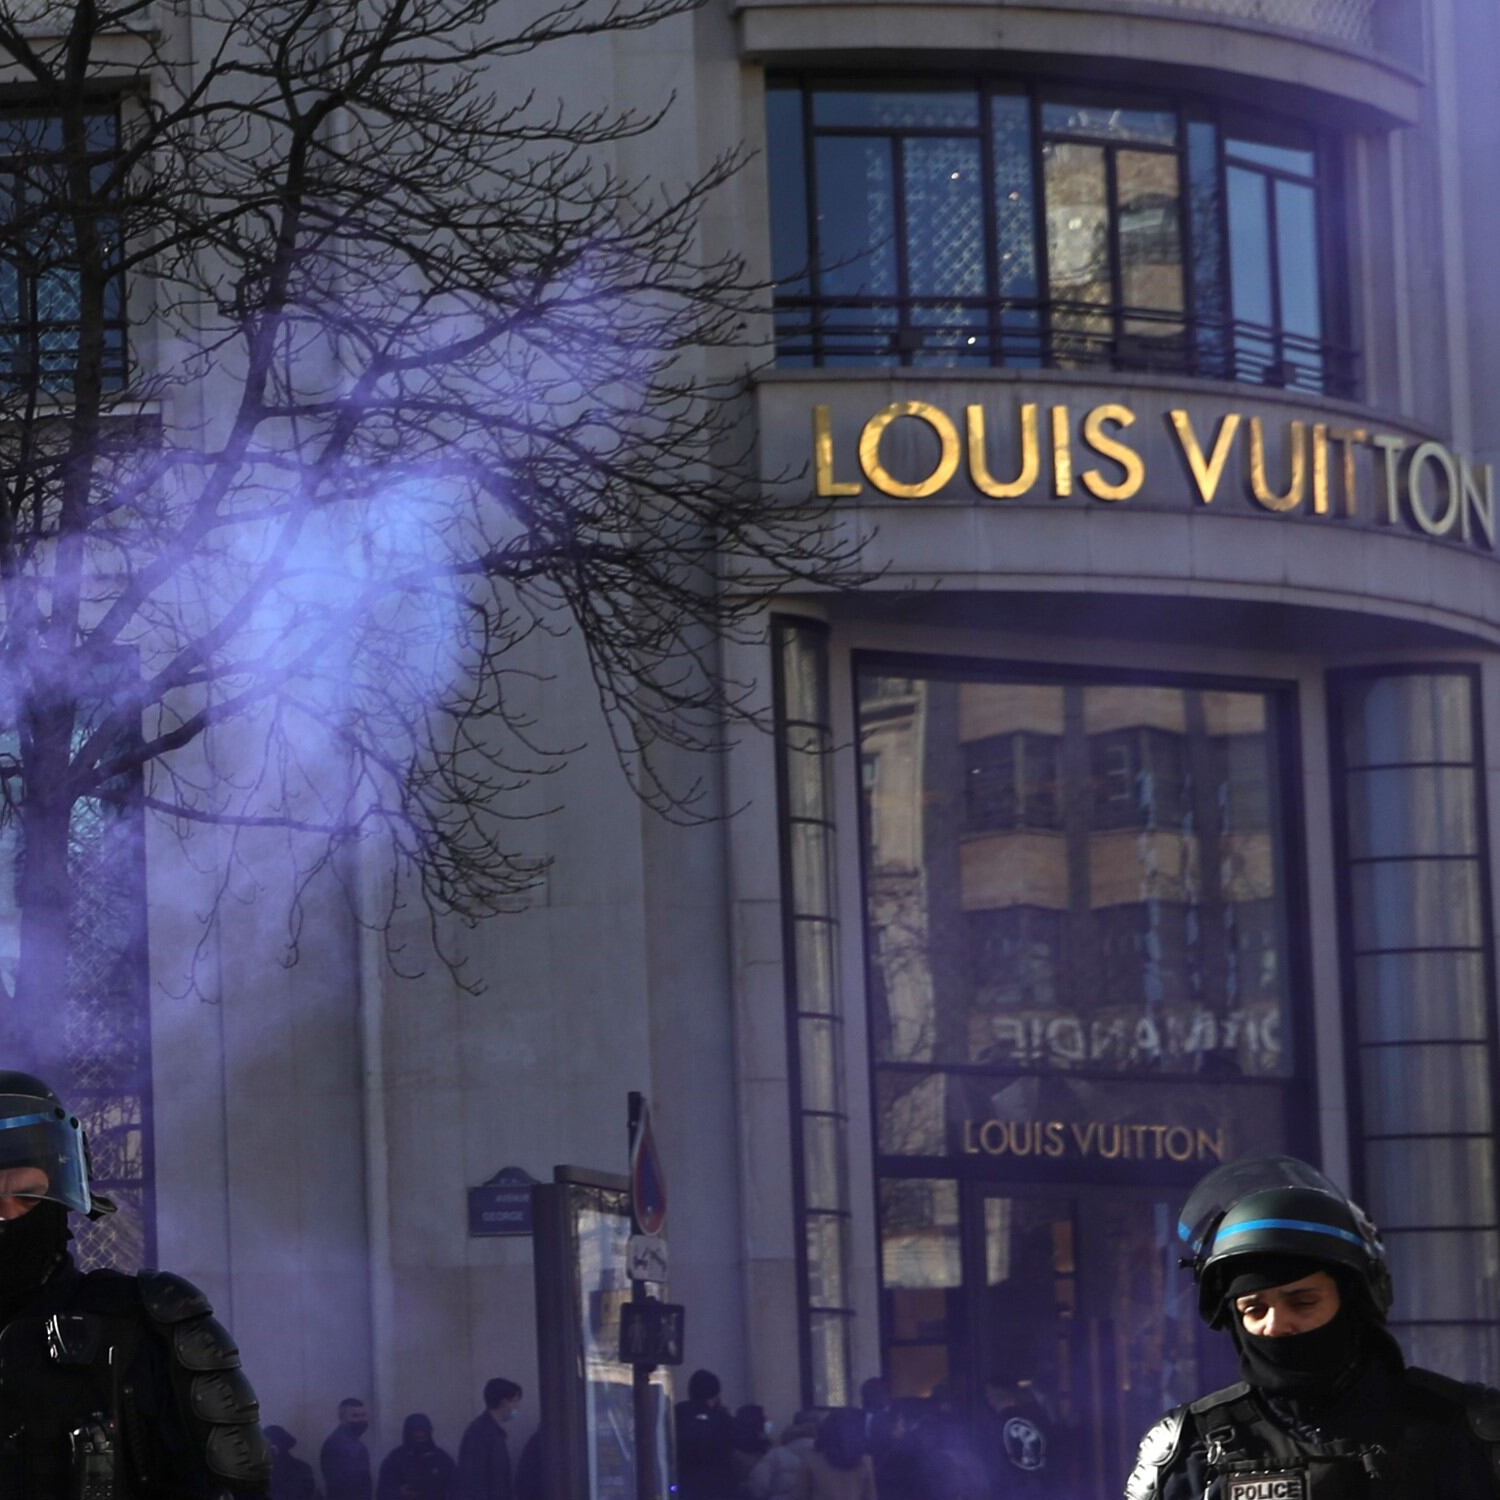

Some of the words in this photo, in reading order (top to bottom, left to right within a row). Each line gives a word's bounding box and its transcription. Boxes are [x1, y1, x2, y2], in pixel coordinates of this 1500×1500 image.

[812, 400, 1145, 501] LOUIS
[1165, 408, 1495, 549] VUITTON
[963, 1119, 1065, 1157] LOUIS
[1071, 1122, 1226, 1161] VUITTON
[481, 1211, 523, 1222] GEORGE
